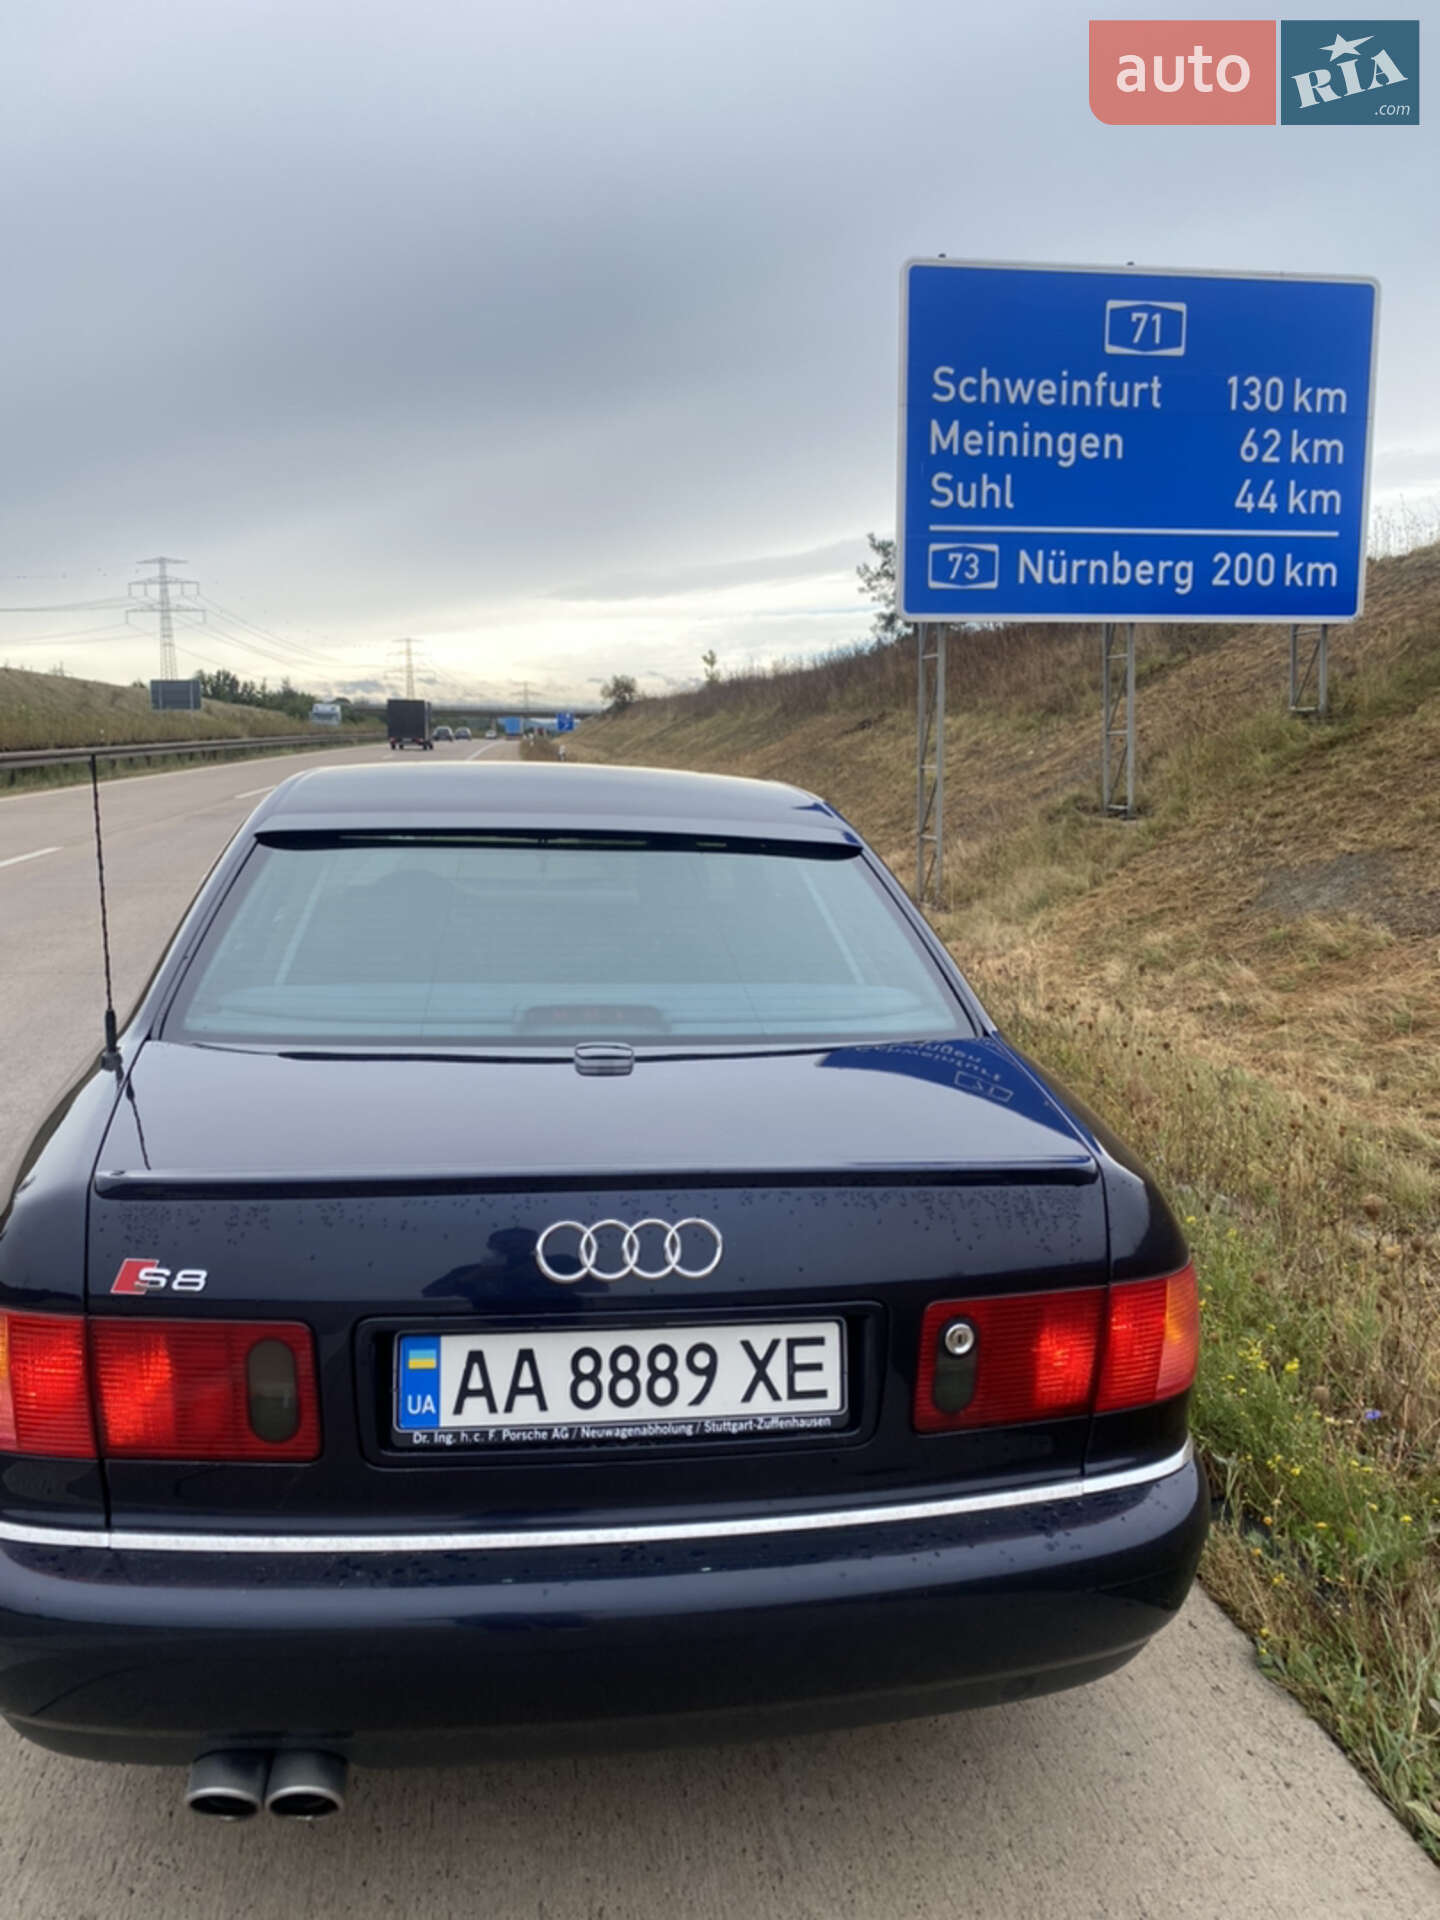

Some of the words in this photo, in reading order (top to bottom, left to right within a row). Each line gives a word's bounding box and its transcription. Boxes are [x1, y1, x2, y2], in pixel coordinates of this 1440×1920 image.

[1130, 313, 1162, 344] 71
[931, 366, 1162, 409] Schweinfurt
[1226, 376, 1284, 412] 130
[1294, 379, 1348, 414] km
[929, 420, 1124, 468] Meiningen
[1240, 429, 1282, 463] 62
[1291, 430, 1344, 465] km
[930, 472, 1015, 510] Suhl
[1234, 480, 1278, 514] 44
[1288, 481, 1342, 515] km
[947, 553, 980, 580] 73
[1018, 549, 1194, 595] Nürnberg
[1211, 552, 1276, 587] 200
[1285, 554, 1338, 588] km
[134, 1267, 208, 1292] S8
[452, 1348, 549, 1416] AA
[569, 1342, 719, 1410] 8889
[739, 1336, 829, 1403] XE
[407, 1393, 436, 1416] UA
[412, 1431, 430, 1444] Dr.
[434, 1431, 456, 1446] Ing.
[502, 1427, 548, 1442] Porsche
[552, 1426, 569, 1440] AG
[581, 1422, 694, 1440] Neuwagenabholung
[704, 1416, 832, 1434] Stuttgart-Zuffenhausen
